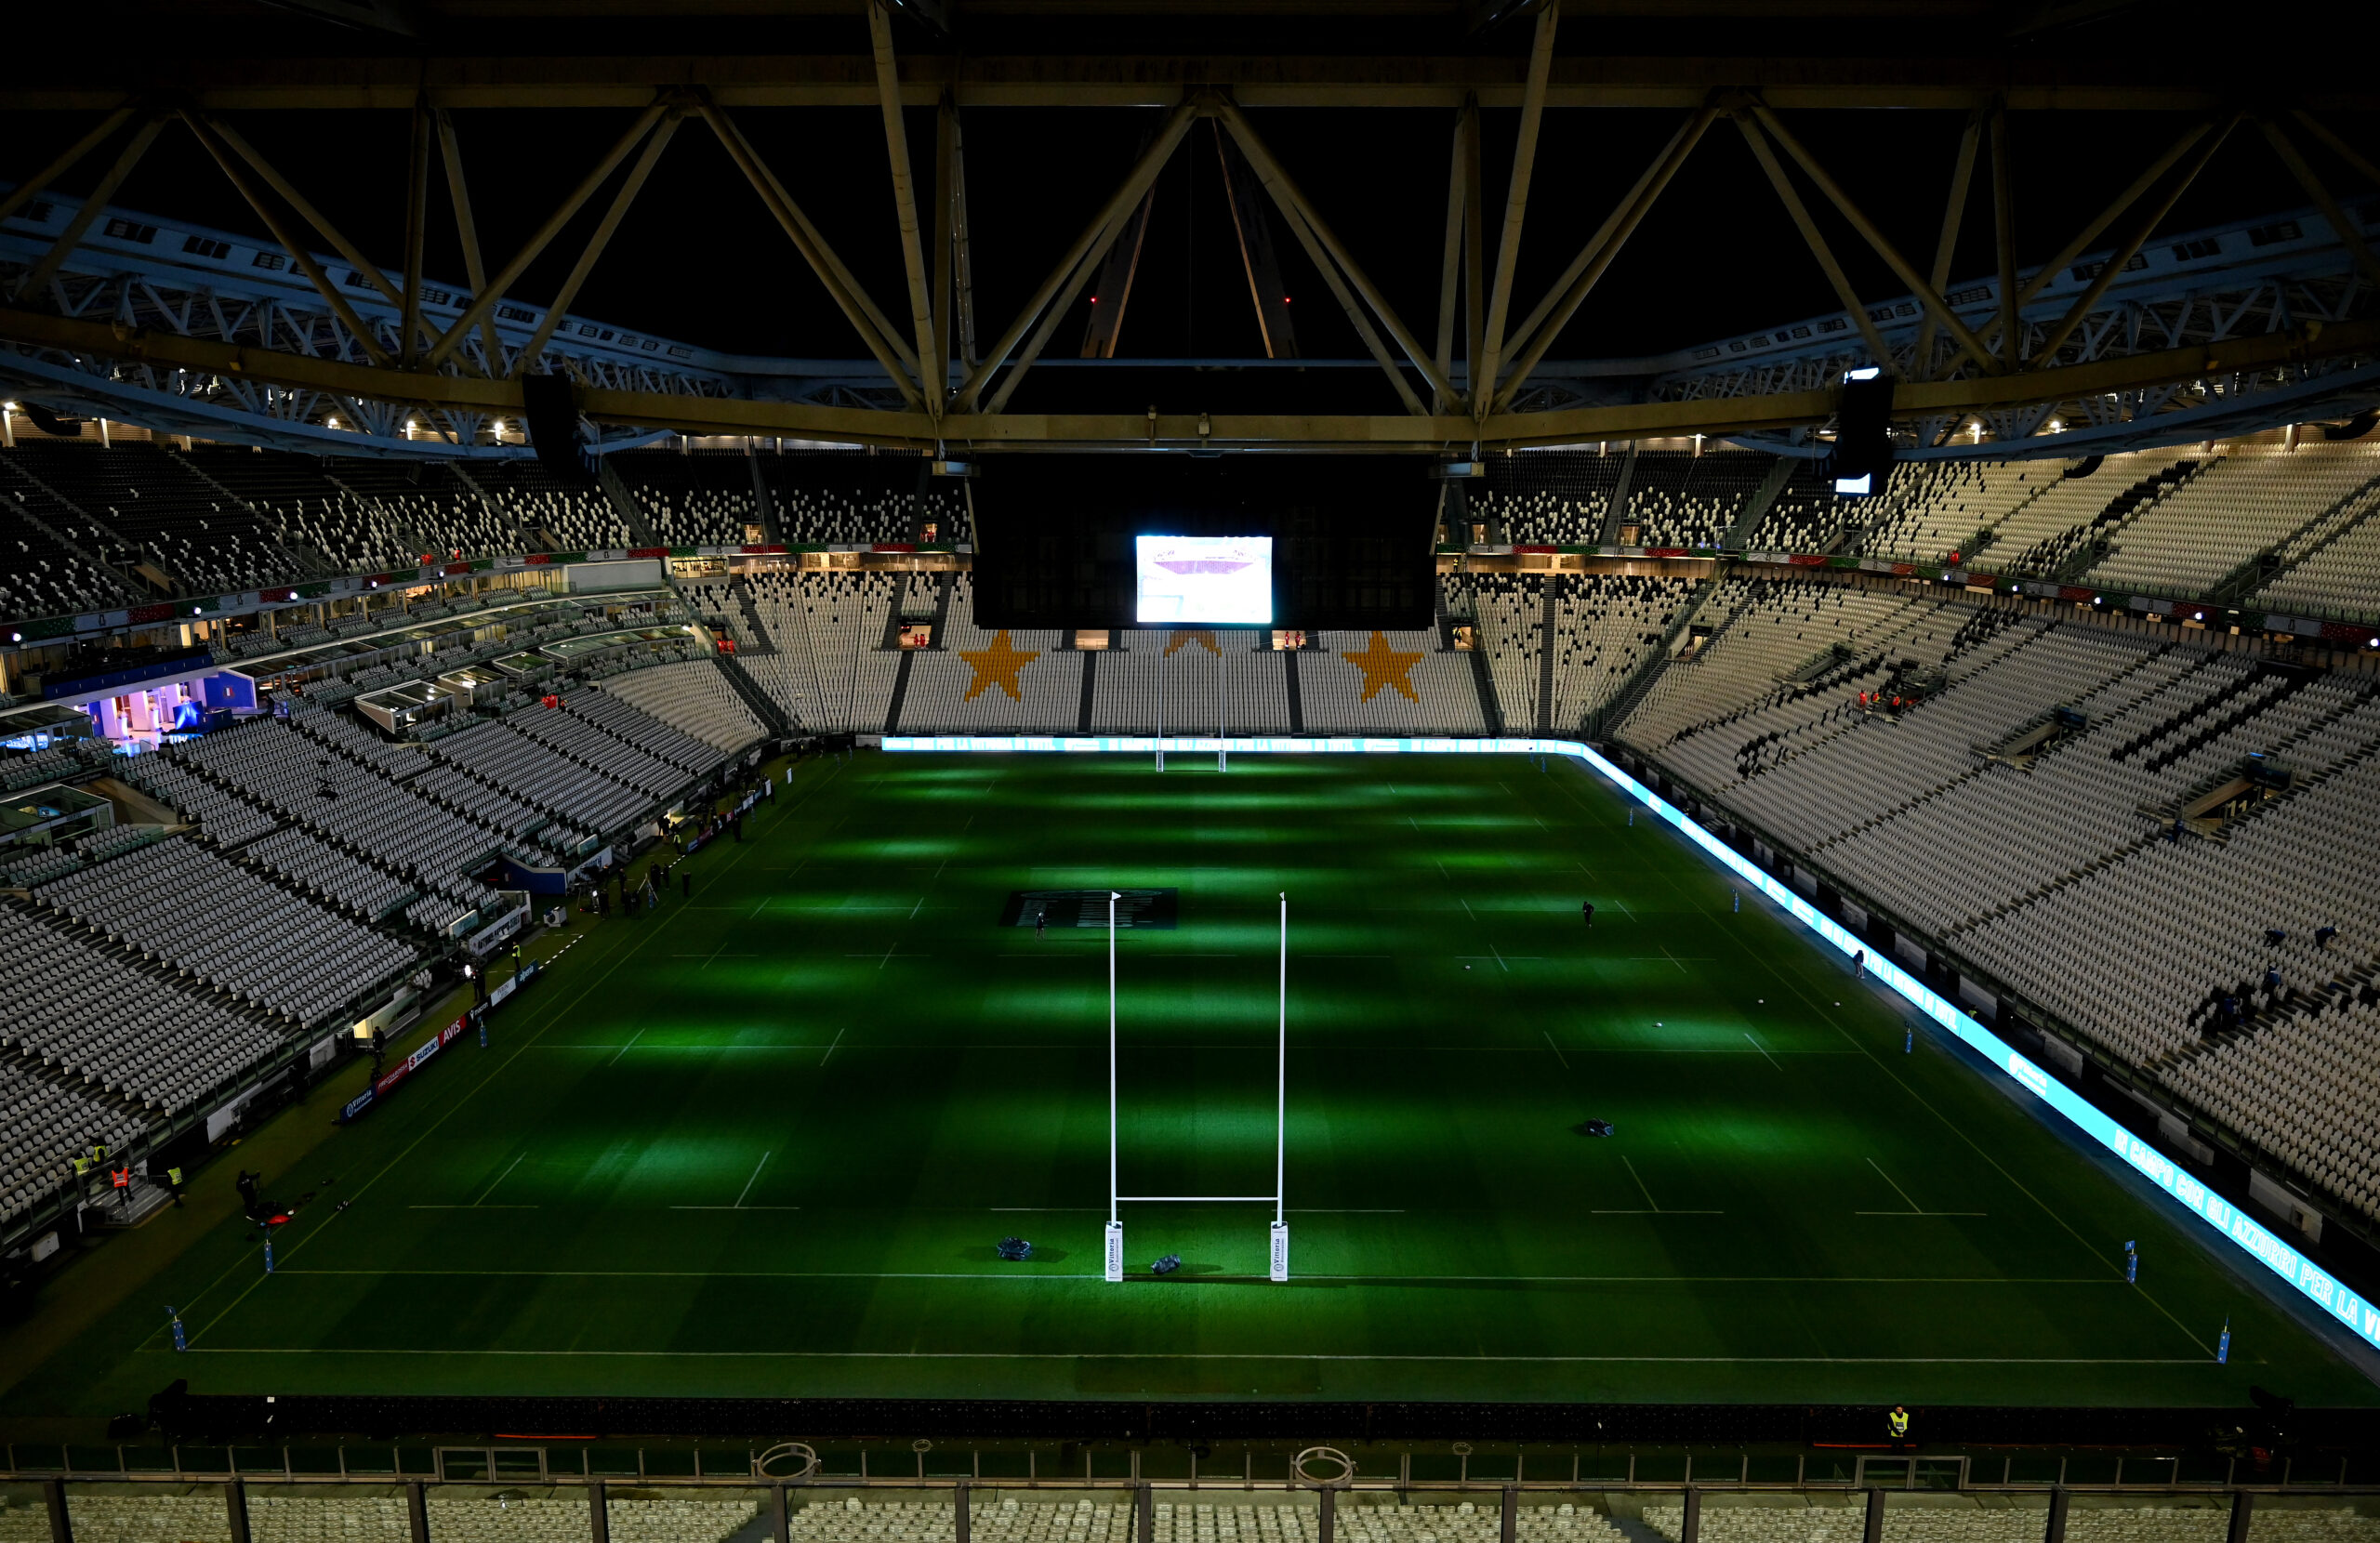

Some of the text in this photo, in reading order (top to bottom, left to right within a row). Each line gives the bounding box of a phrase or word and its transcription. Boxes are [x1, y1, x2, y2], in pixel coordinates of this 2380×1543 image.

[475, 1001, 489, 1016] macron
[443, 1020, 461, 1044] AVIS
[416, 1040, 439, 1062] SUZUKI
[351, 1089, 372, 1108] Vittoria
[2129, 1141, 2174, 1187] CAMPO
[2175, 1174, 2205, 1210] CON
[2206, 1196, 2230, 1230] GLI
[2231, 1216, 2297, 1279] AZZURRI
[2299, 1263, 2334, 1306] PER
[2335, 1289, 2359, 1325] LA
